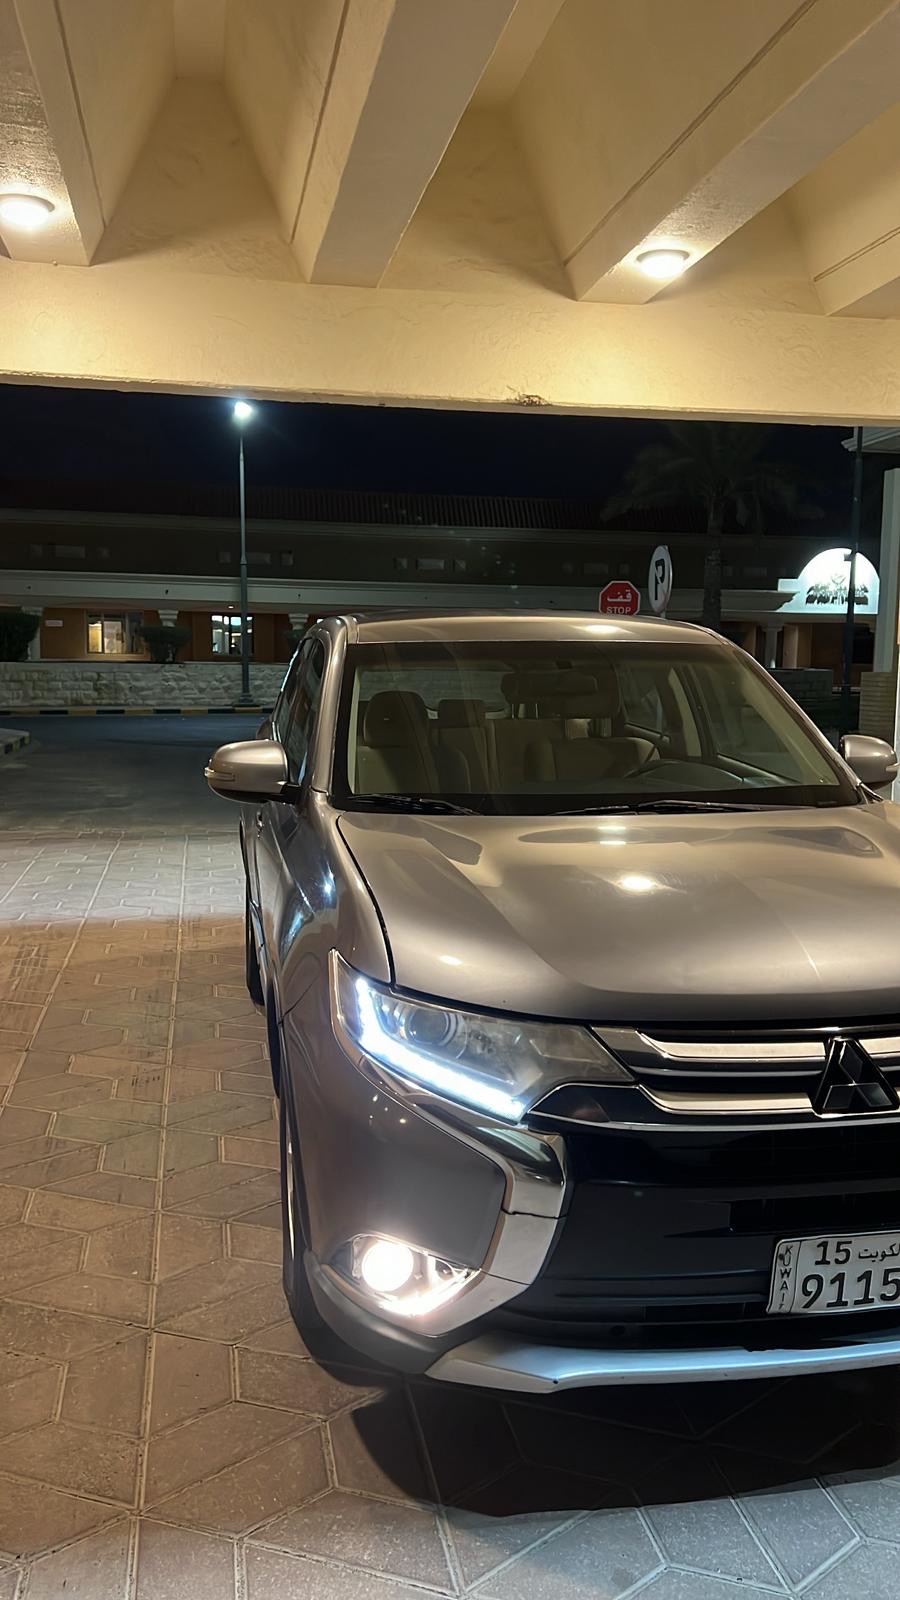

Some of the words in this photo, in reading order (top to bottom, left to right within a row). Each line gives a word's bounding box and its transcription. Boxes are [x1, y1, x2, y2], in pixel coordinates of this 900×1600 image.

[655, 558, 665, 600] P
[607, 589, 632, 602] قف
[607, 606, 631, 614] STOP
[815, 1241, 852, 1265] 15
[858, 1243, 900, 1262] لكويت
[779, 1245, 793, 1310] KUWAIT
[801, 1268, 900, 1308] 9115
